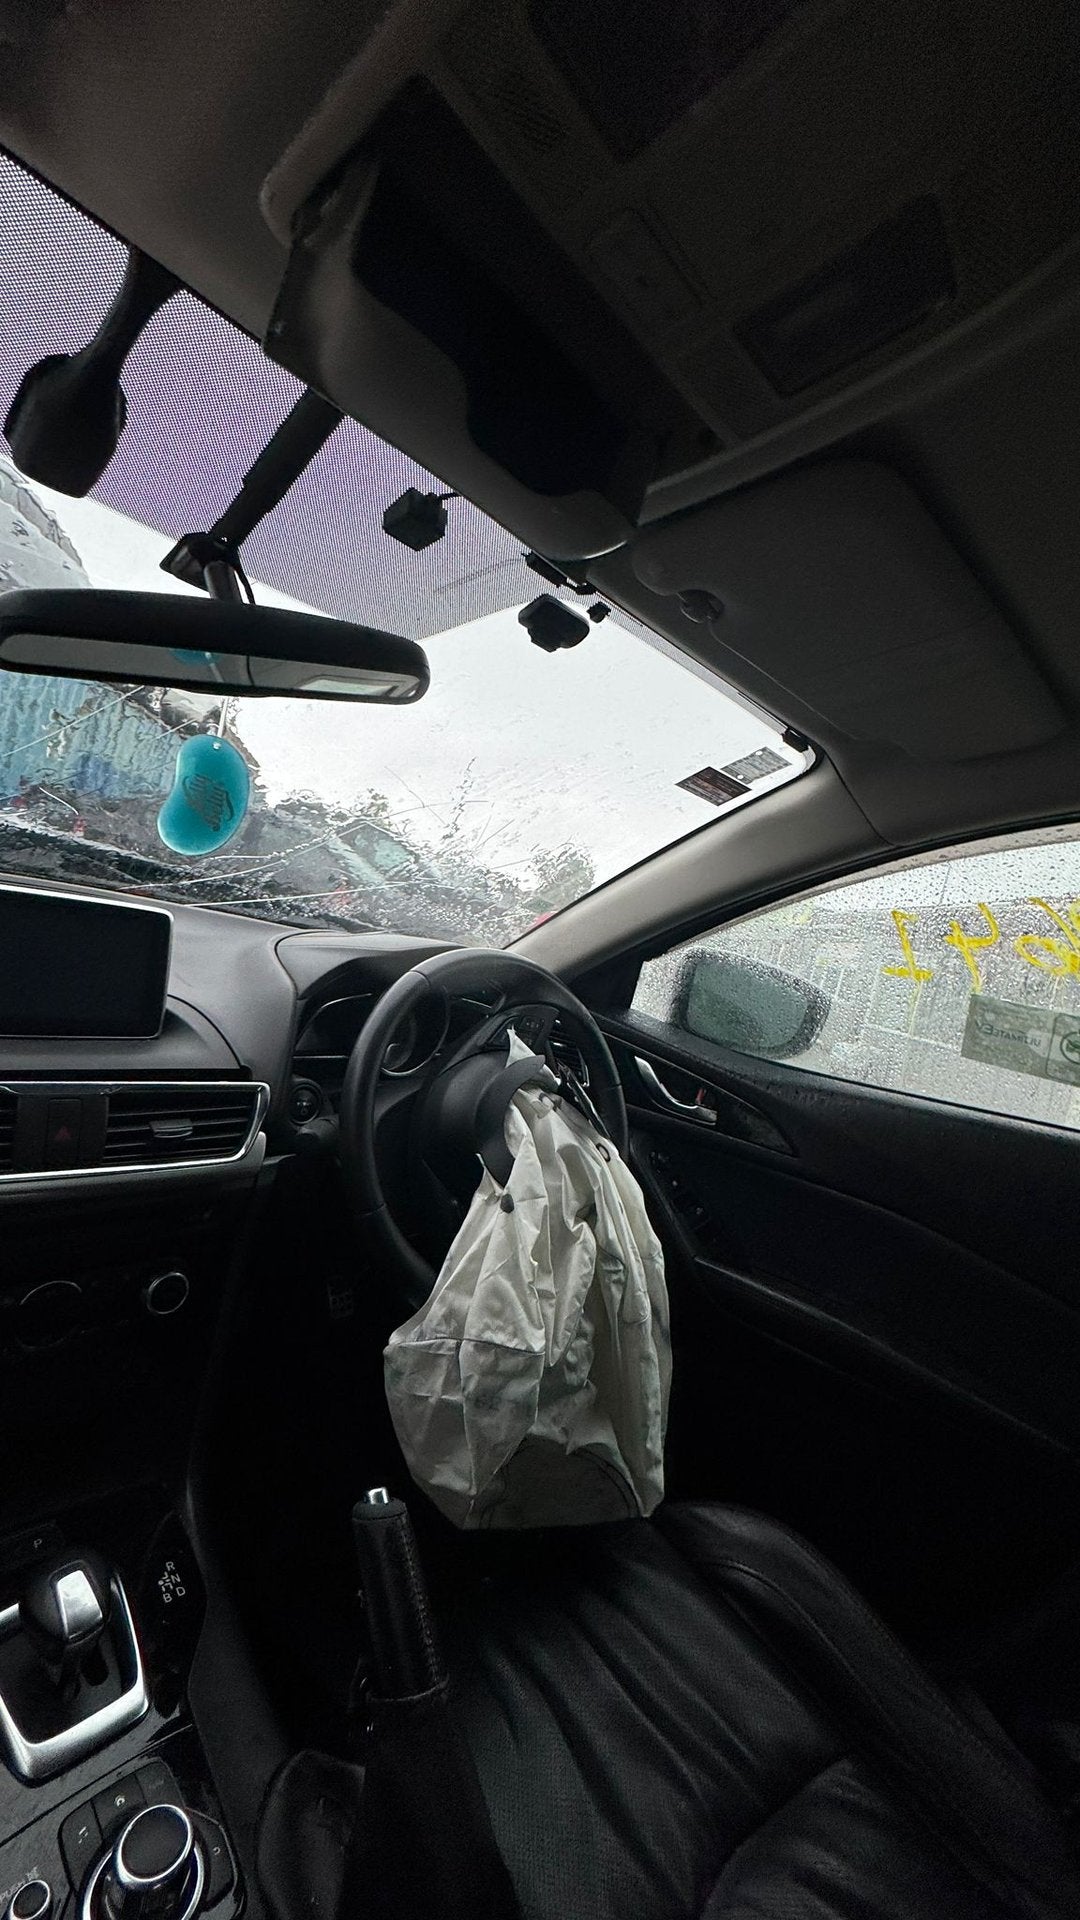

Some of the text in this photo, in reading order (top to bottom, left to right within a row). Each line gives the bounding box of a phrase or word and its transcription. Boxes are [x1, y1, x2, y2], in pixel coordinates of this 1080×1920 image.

[33, 1538, 43, 1550] P
[165, 1560, 176, 1572] R
[170, 1572, 182, 1584] N
[162, 1592, 173, 1604] B
[176, 1586, 186, 1598] D
